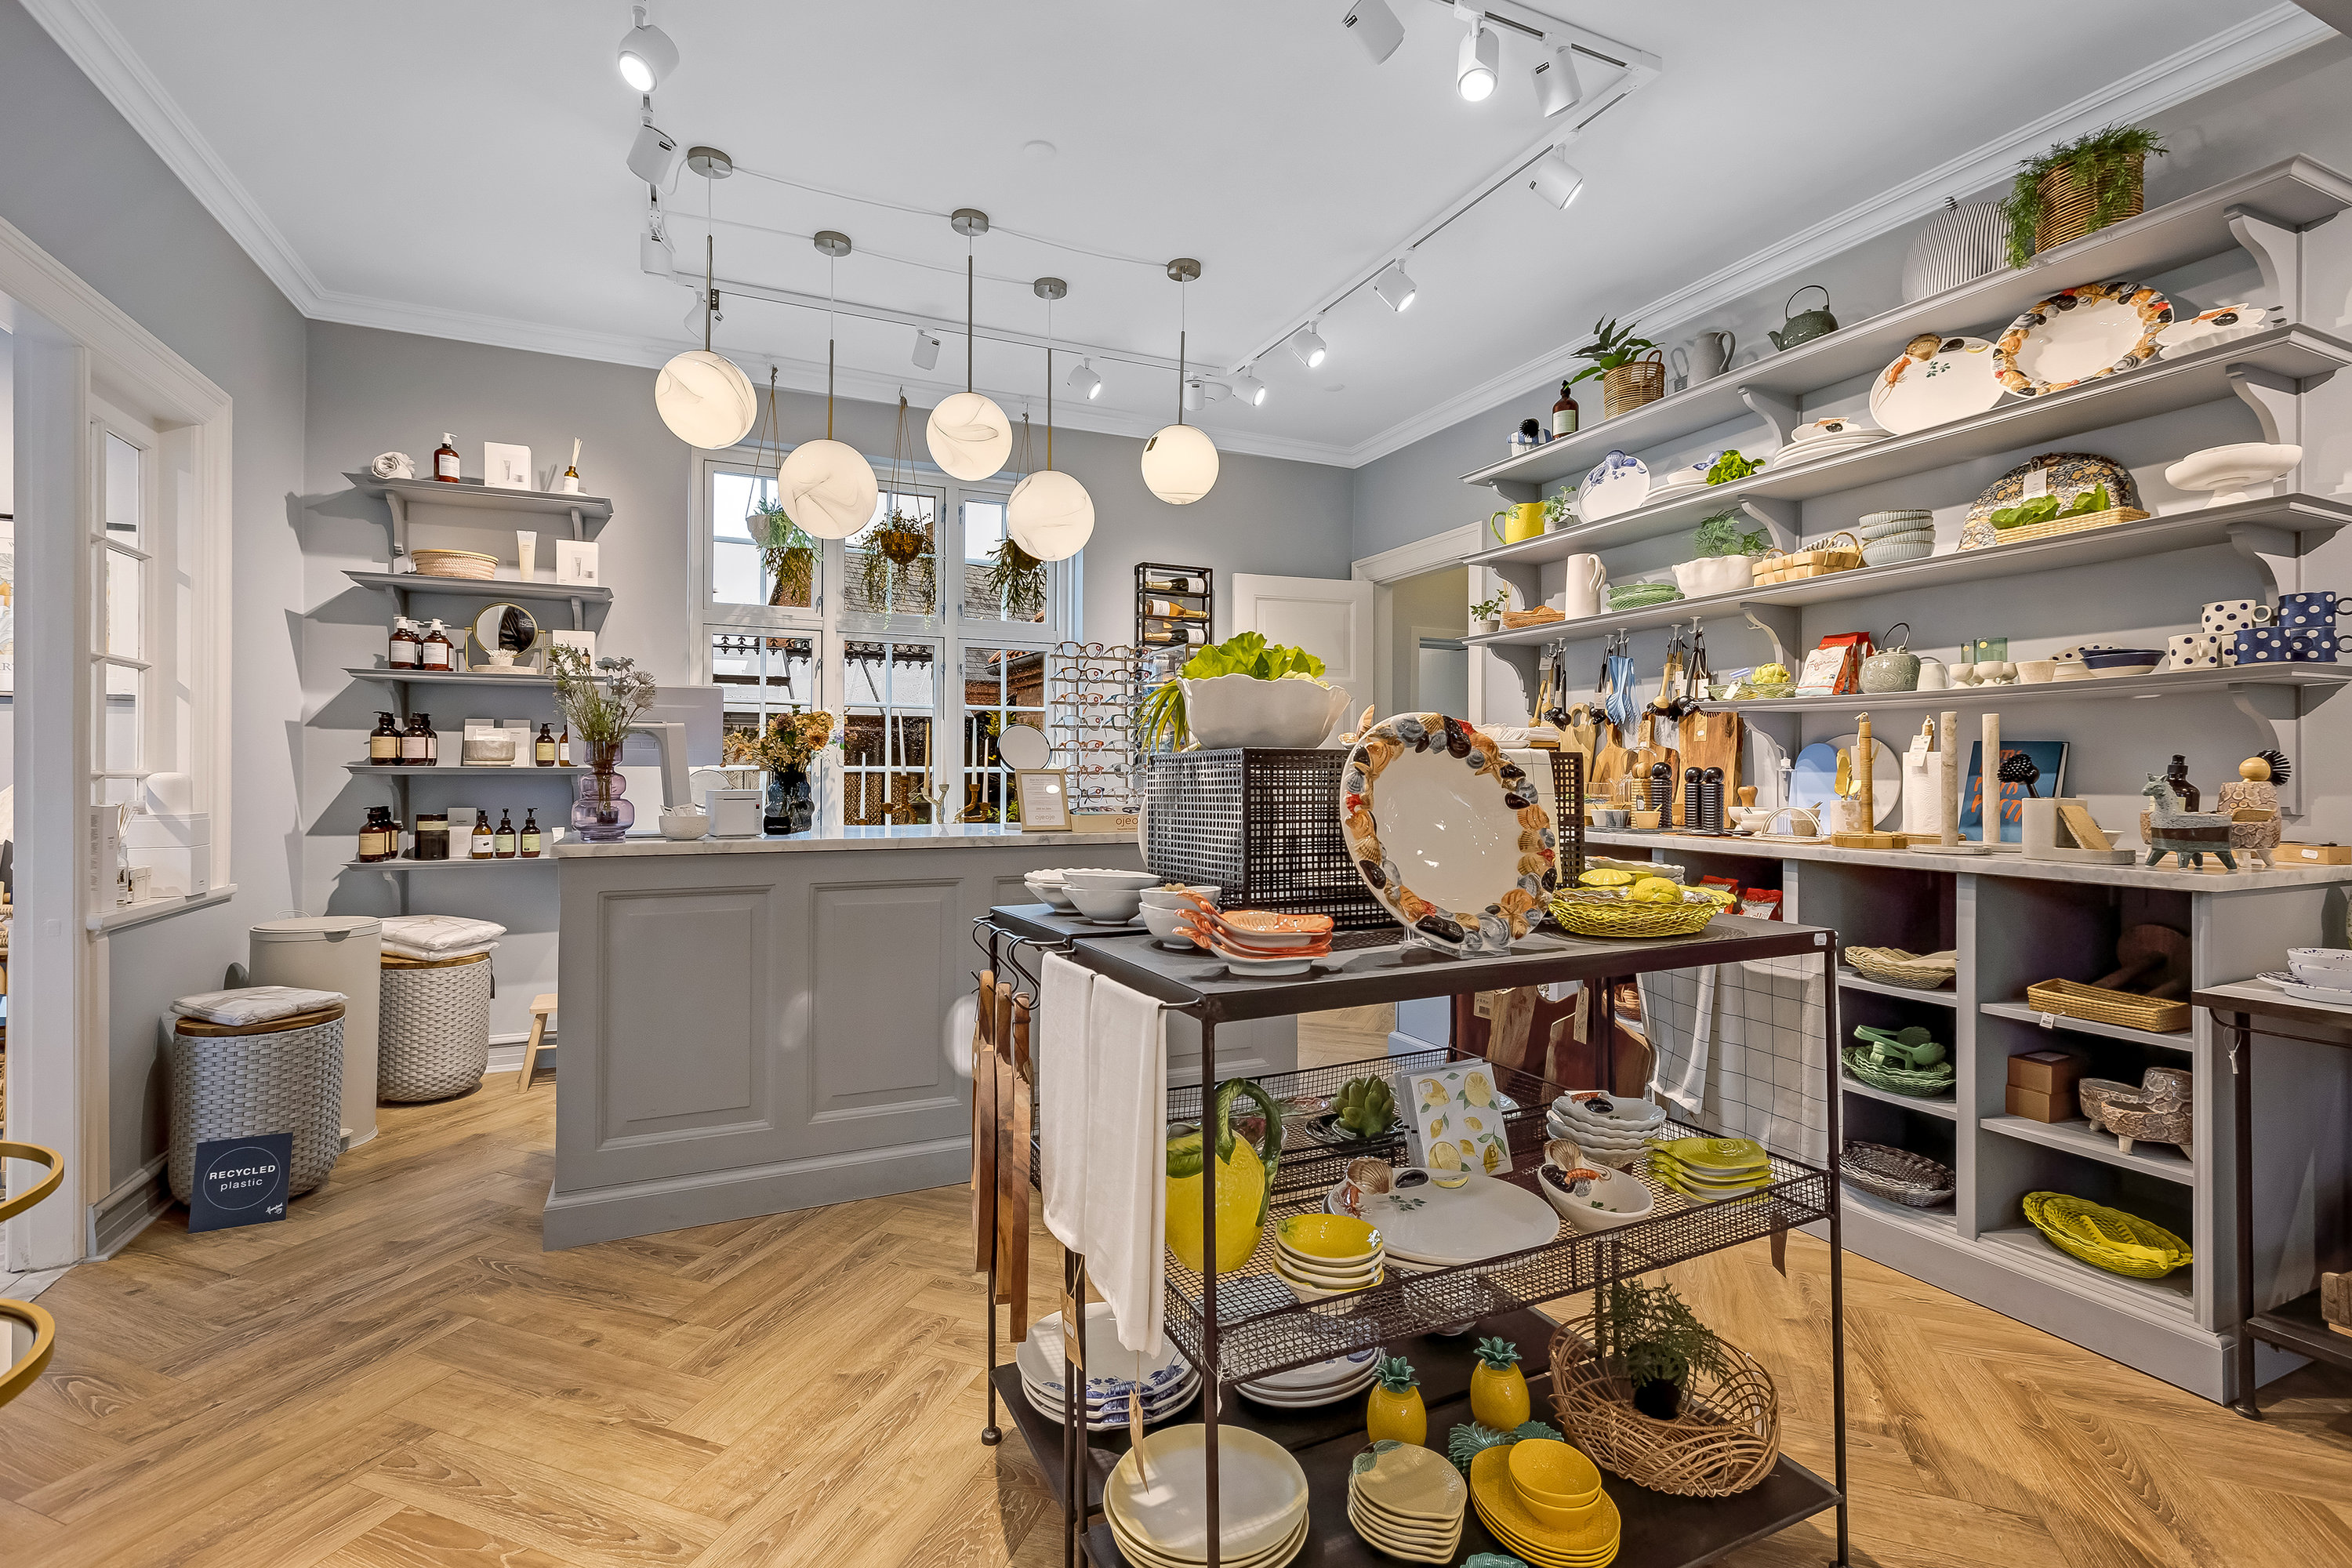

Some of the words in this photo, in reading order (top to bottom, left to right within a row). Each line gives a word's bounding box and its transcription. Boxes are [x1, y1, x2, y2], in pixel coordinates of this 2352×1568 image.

[1116, 815, 1139, 827] ojeo
[209, 1165, 276, 1180] RECYCLED
[220, 1178, 263, 1192] plastic
